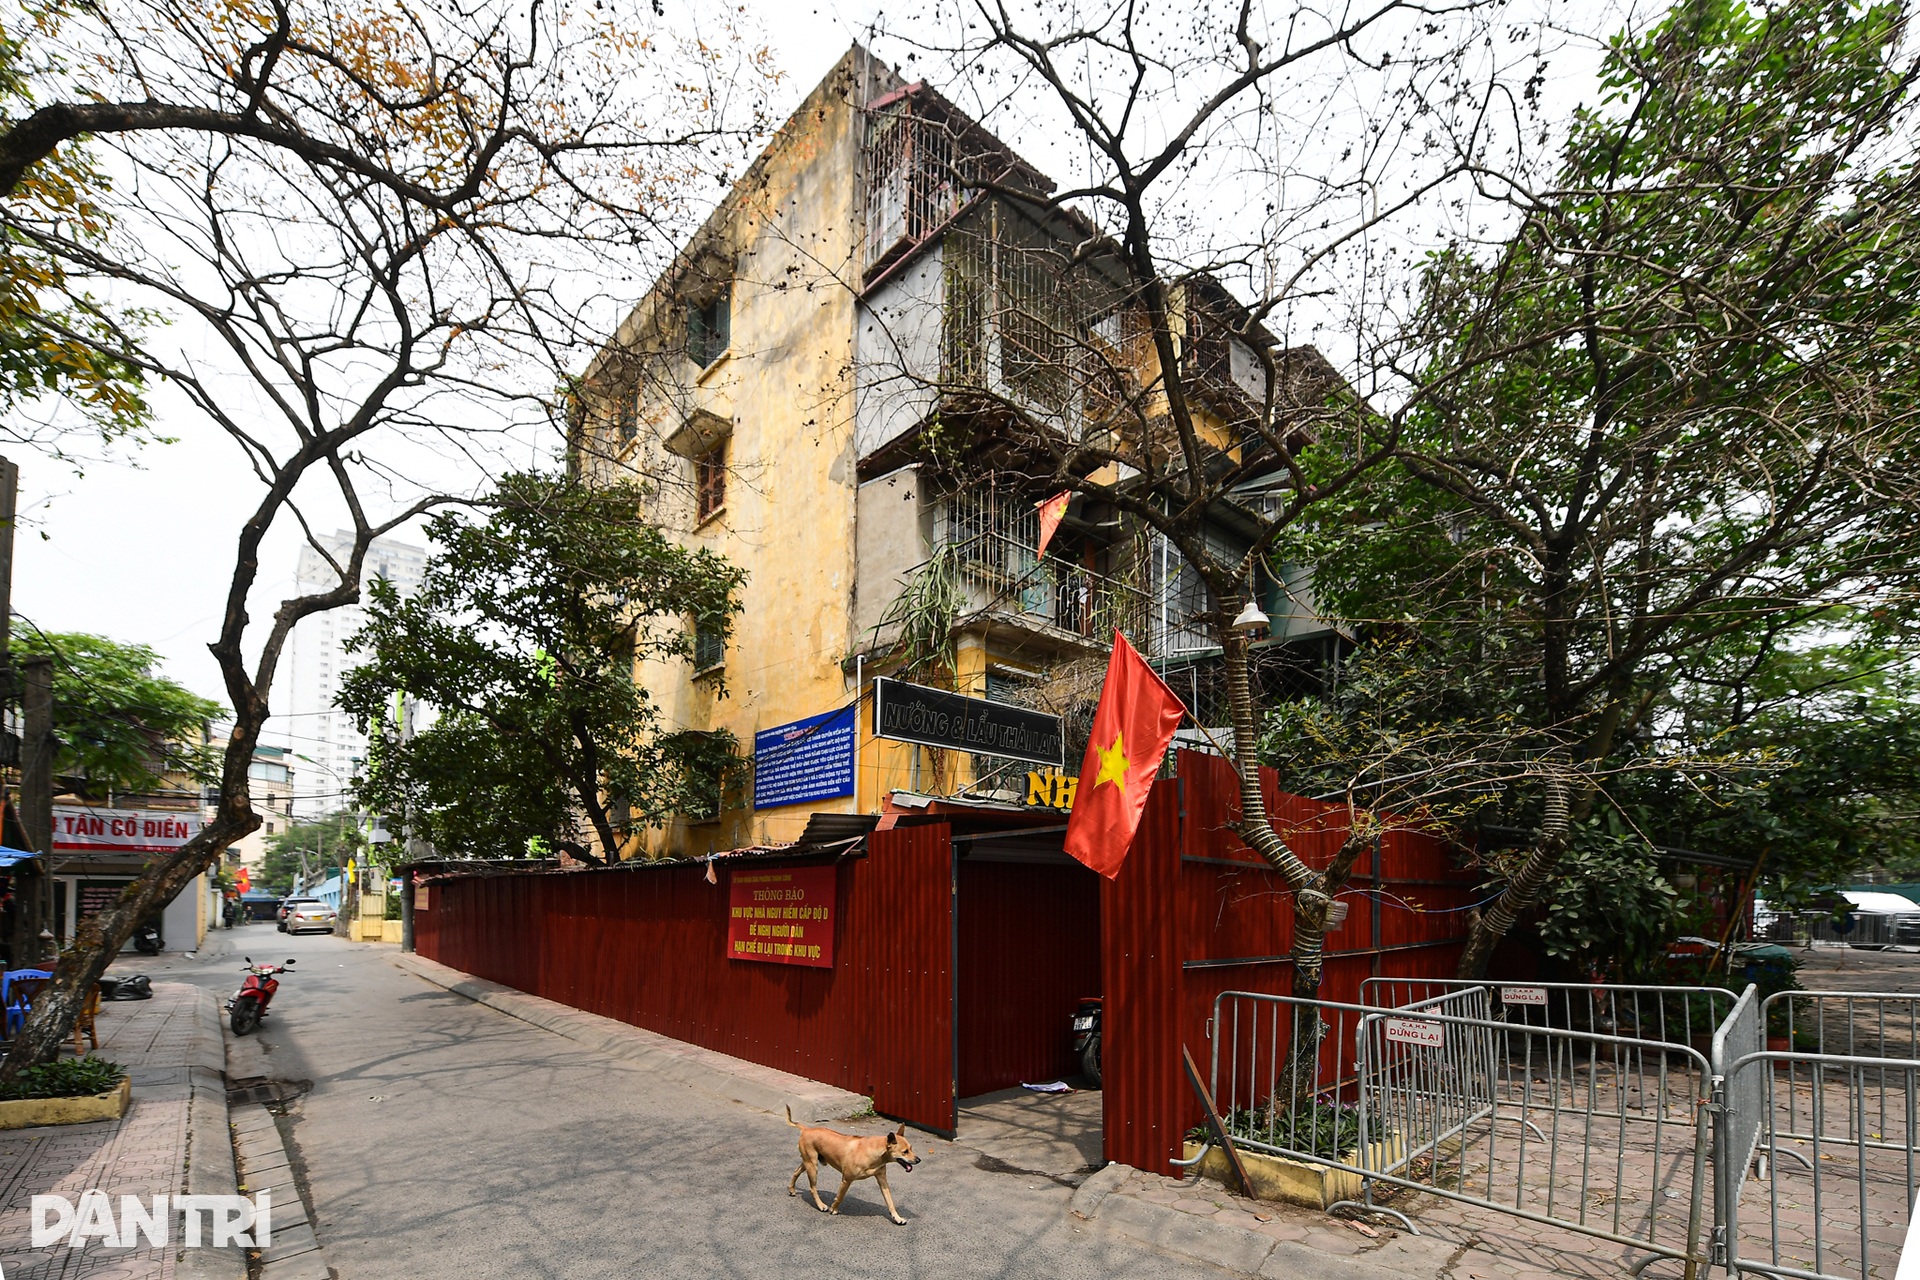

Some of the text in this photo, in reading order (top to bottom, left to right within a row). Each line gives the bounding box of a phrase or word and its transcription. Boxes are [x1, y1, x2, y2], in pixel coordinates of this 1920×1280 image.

[884, 700, 1061, 758] NƯỚNG & LẨU THÁI LAN
[64, 813, 104, 836] TÂN
[111, 813, 139, 837] CỔ
[143, 815, 188, 839] ĐIỂN
[753, 886, 805, 901] THÔNG BÁO
[799, 903, 812, 919] CẤP
[823, 907, 829, 920] D
[791, 923, 804, 938] DÂN
[764, 942, 773, 957] LẠI
[774, 943, 793, 956] TRONG
[794, 944, 807, 957] KHU
[808, 944, 821, 961] VỰC
[1390, 1027, 1439, 1042] DỪNG LẠI
